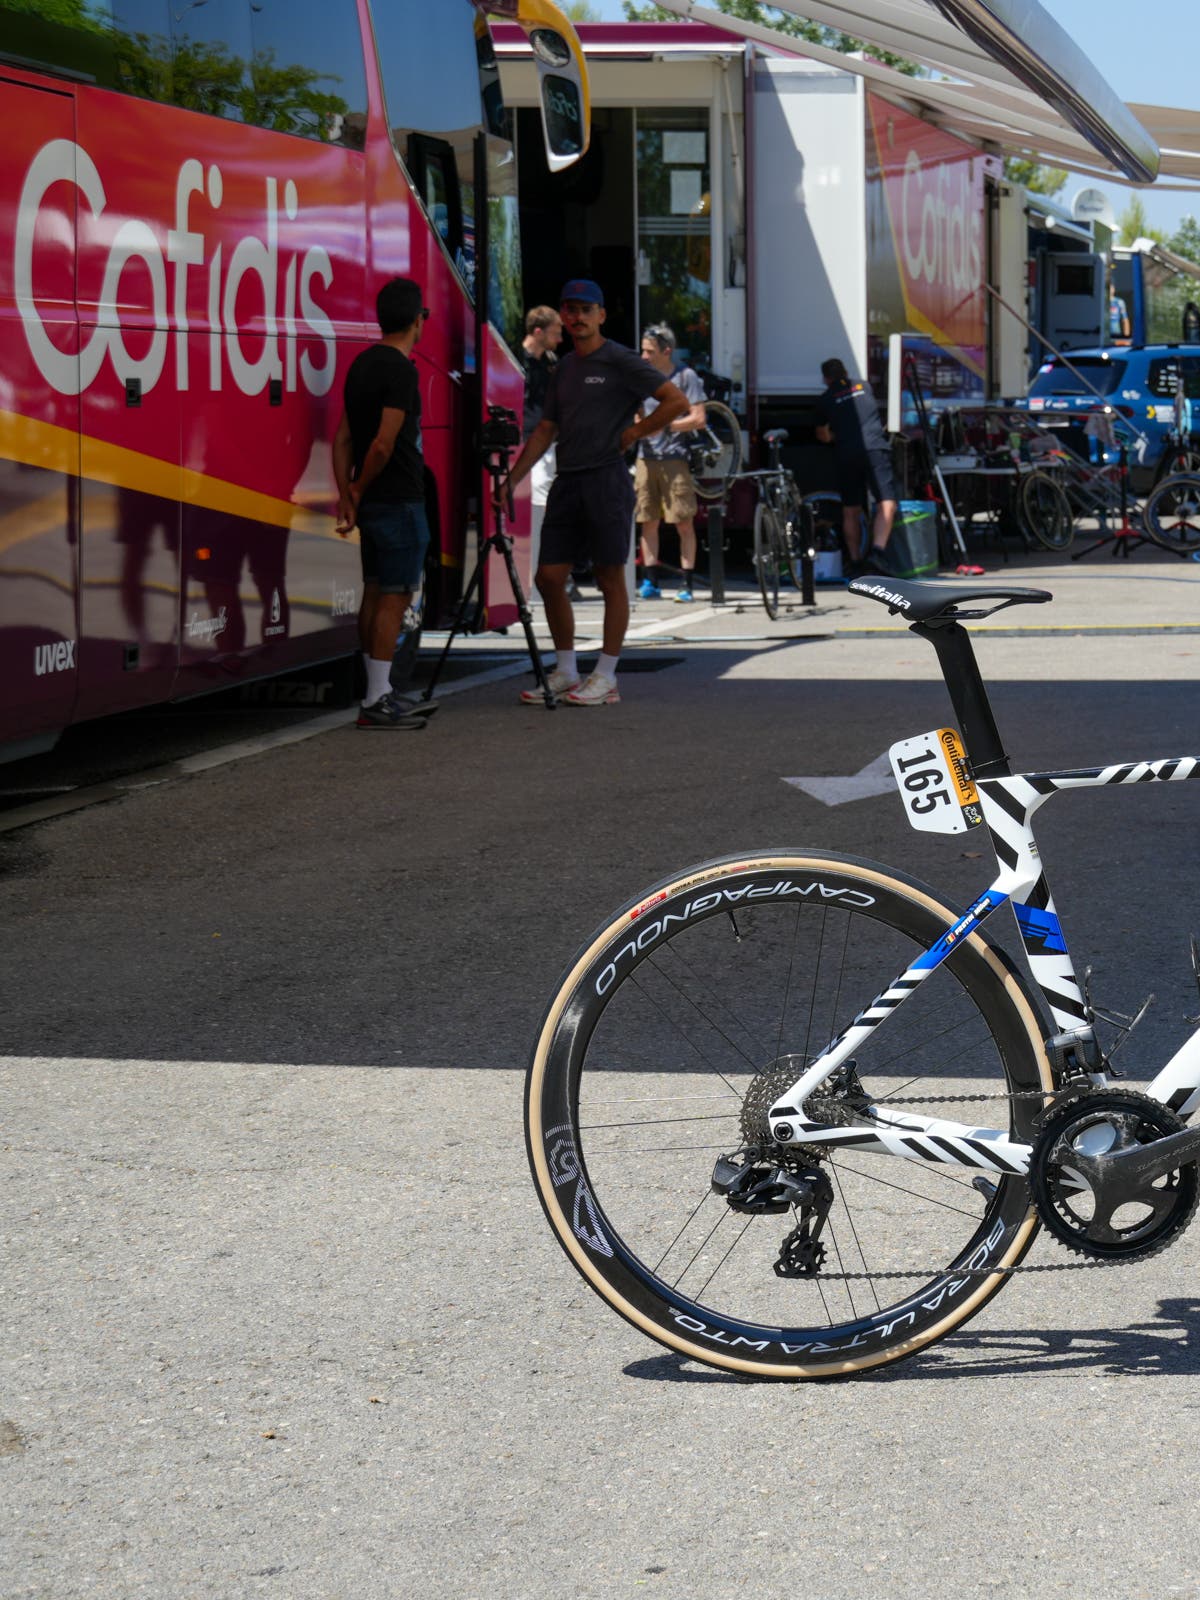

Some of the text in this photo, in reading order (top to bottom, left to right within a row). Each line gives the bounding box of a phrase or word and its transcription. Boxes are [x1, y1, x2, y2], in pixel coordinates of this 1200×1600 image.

[14, 138, 337, 397] Cofidis
[903, 149, 981, 290] Cofidis
[34, 640, 75, 676] uvex
[897, 748, 952, 815] 165
[941, 732, 970, 792] Continental
[596, 880, 876, 997] CAMPAGNOLO
[674, 1217, 1005, 1355] BORA ULTRA WTO
